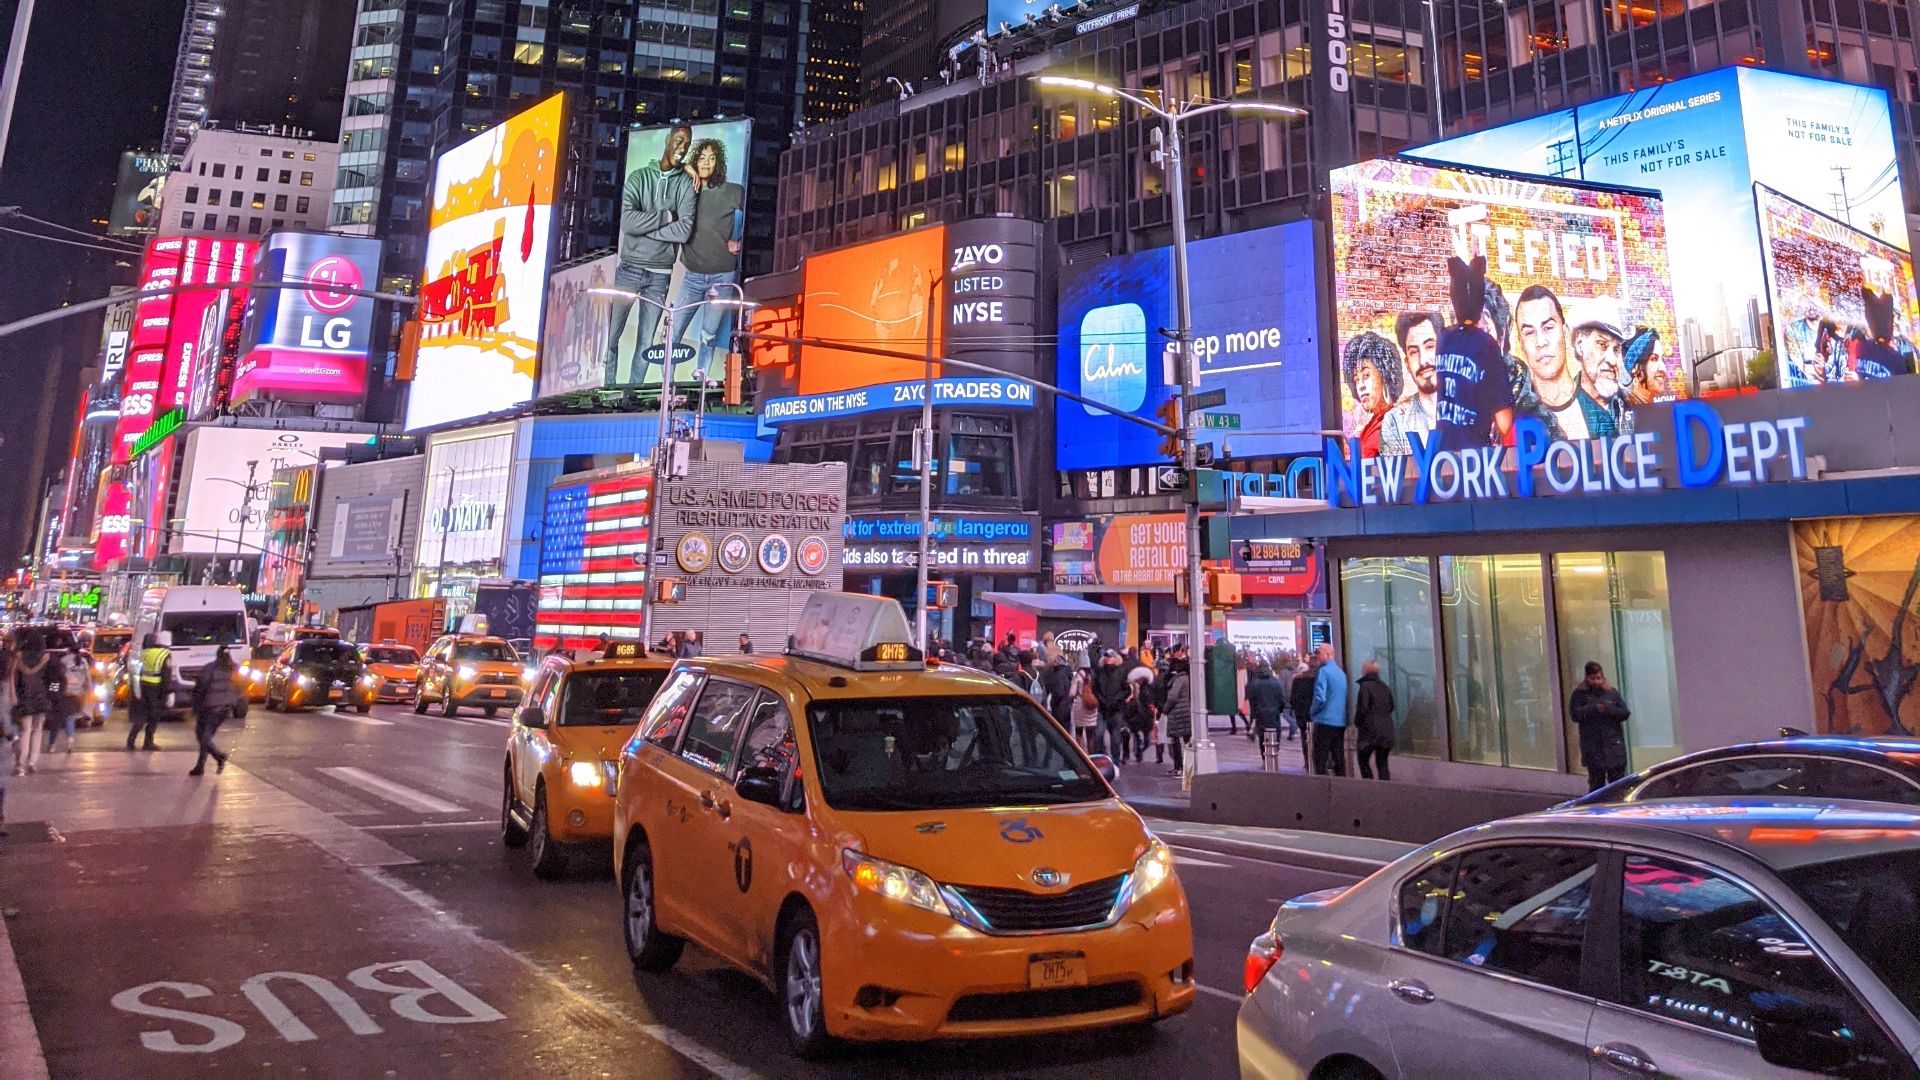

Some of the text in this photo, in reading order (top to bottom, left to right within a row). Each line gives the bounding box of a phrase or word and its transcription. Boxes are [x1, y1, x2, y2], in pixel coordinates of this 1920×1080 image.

[1077, 8, 1137, 32] OUTFRONT PRIME
[1599, 91, 1721, 130] A NETFLIX ORIGINAL SERIES
[1786, 117, 1850, 135] THIS FAMILY'S
[1788, 129, 1852, 146] NOT FOR SALE
[1603, 139, 1685, 167] THIS FAMILY'S
[1640, 146, 1726, 174] NOT FOR SALE
[952, 244, 1003, 270] ZAYO
[954, 277, 1003, 293] LISTED
[953, 302, 1003, 324] NYSE
[300, 315, 352, 349] LG
[647, 348, 690, 360] OLD AVY
[1166, 327, 1281, 363] slep more
[1083, 343, 1143, 382] Calm
[934, 382, 1001, 399] TRADES
[1006, 384, 1030, 400] ON
[771, 400, 807, 417] TRADES
[809, 397, 825, 413] ON
[827, 395, 845, 411] THE
[846, 391, 868, 409] NYSE.
[1206, 414, 1215, 428] W
[1219, 415, 1230, 428] 43
[1327, 400, 1807, 507] NEW YORK POLICE DEPT
[1166, 474, 1182, 482] ONE
[669, 486, 840, 513] U.S. ARMED FORCES
[454, 503, 491, 532] NAVY
[676, 510, 832, 530] RECRUITING STATION
[858, 520, 874, 536] for
[863, 548, 888, 564] also
[962, 549, 978, 564] in
[1263, 544, 1280, 559] 984
[1281, 544, 1300, 559] 8126
[1268, 575, 1285, 584] CBRE
[881, 644, 905, 659] 2H75
[1057, 639, 1089, 652] STRAN
[110, 959, 508, 1053] BUS
